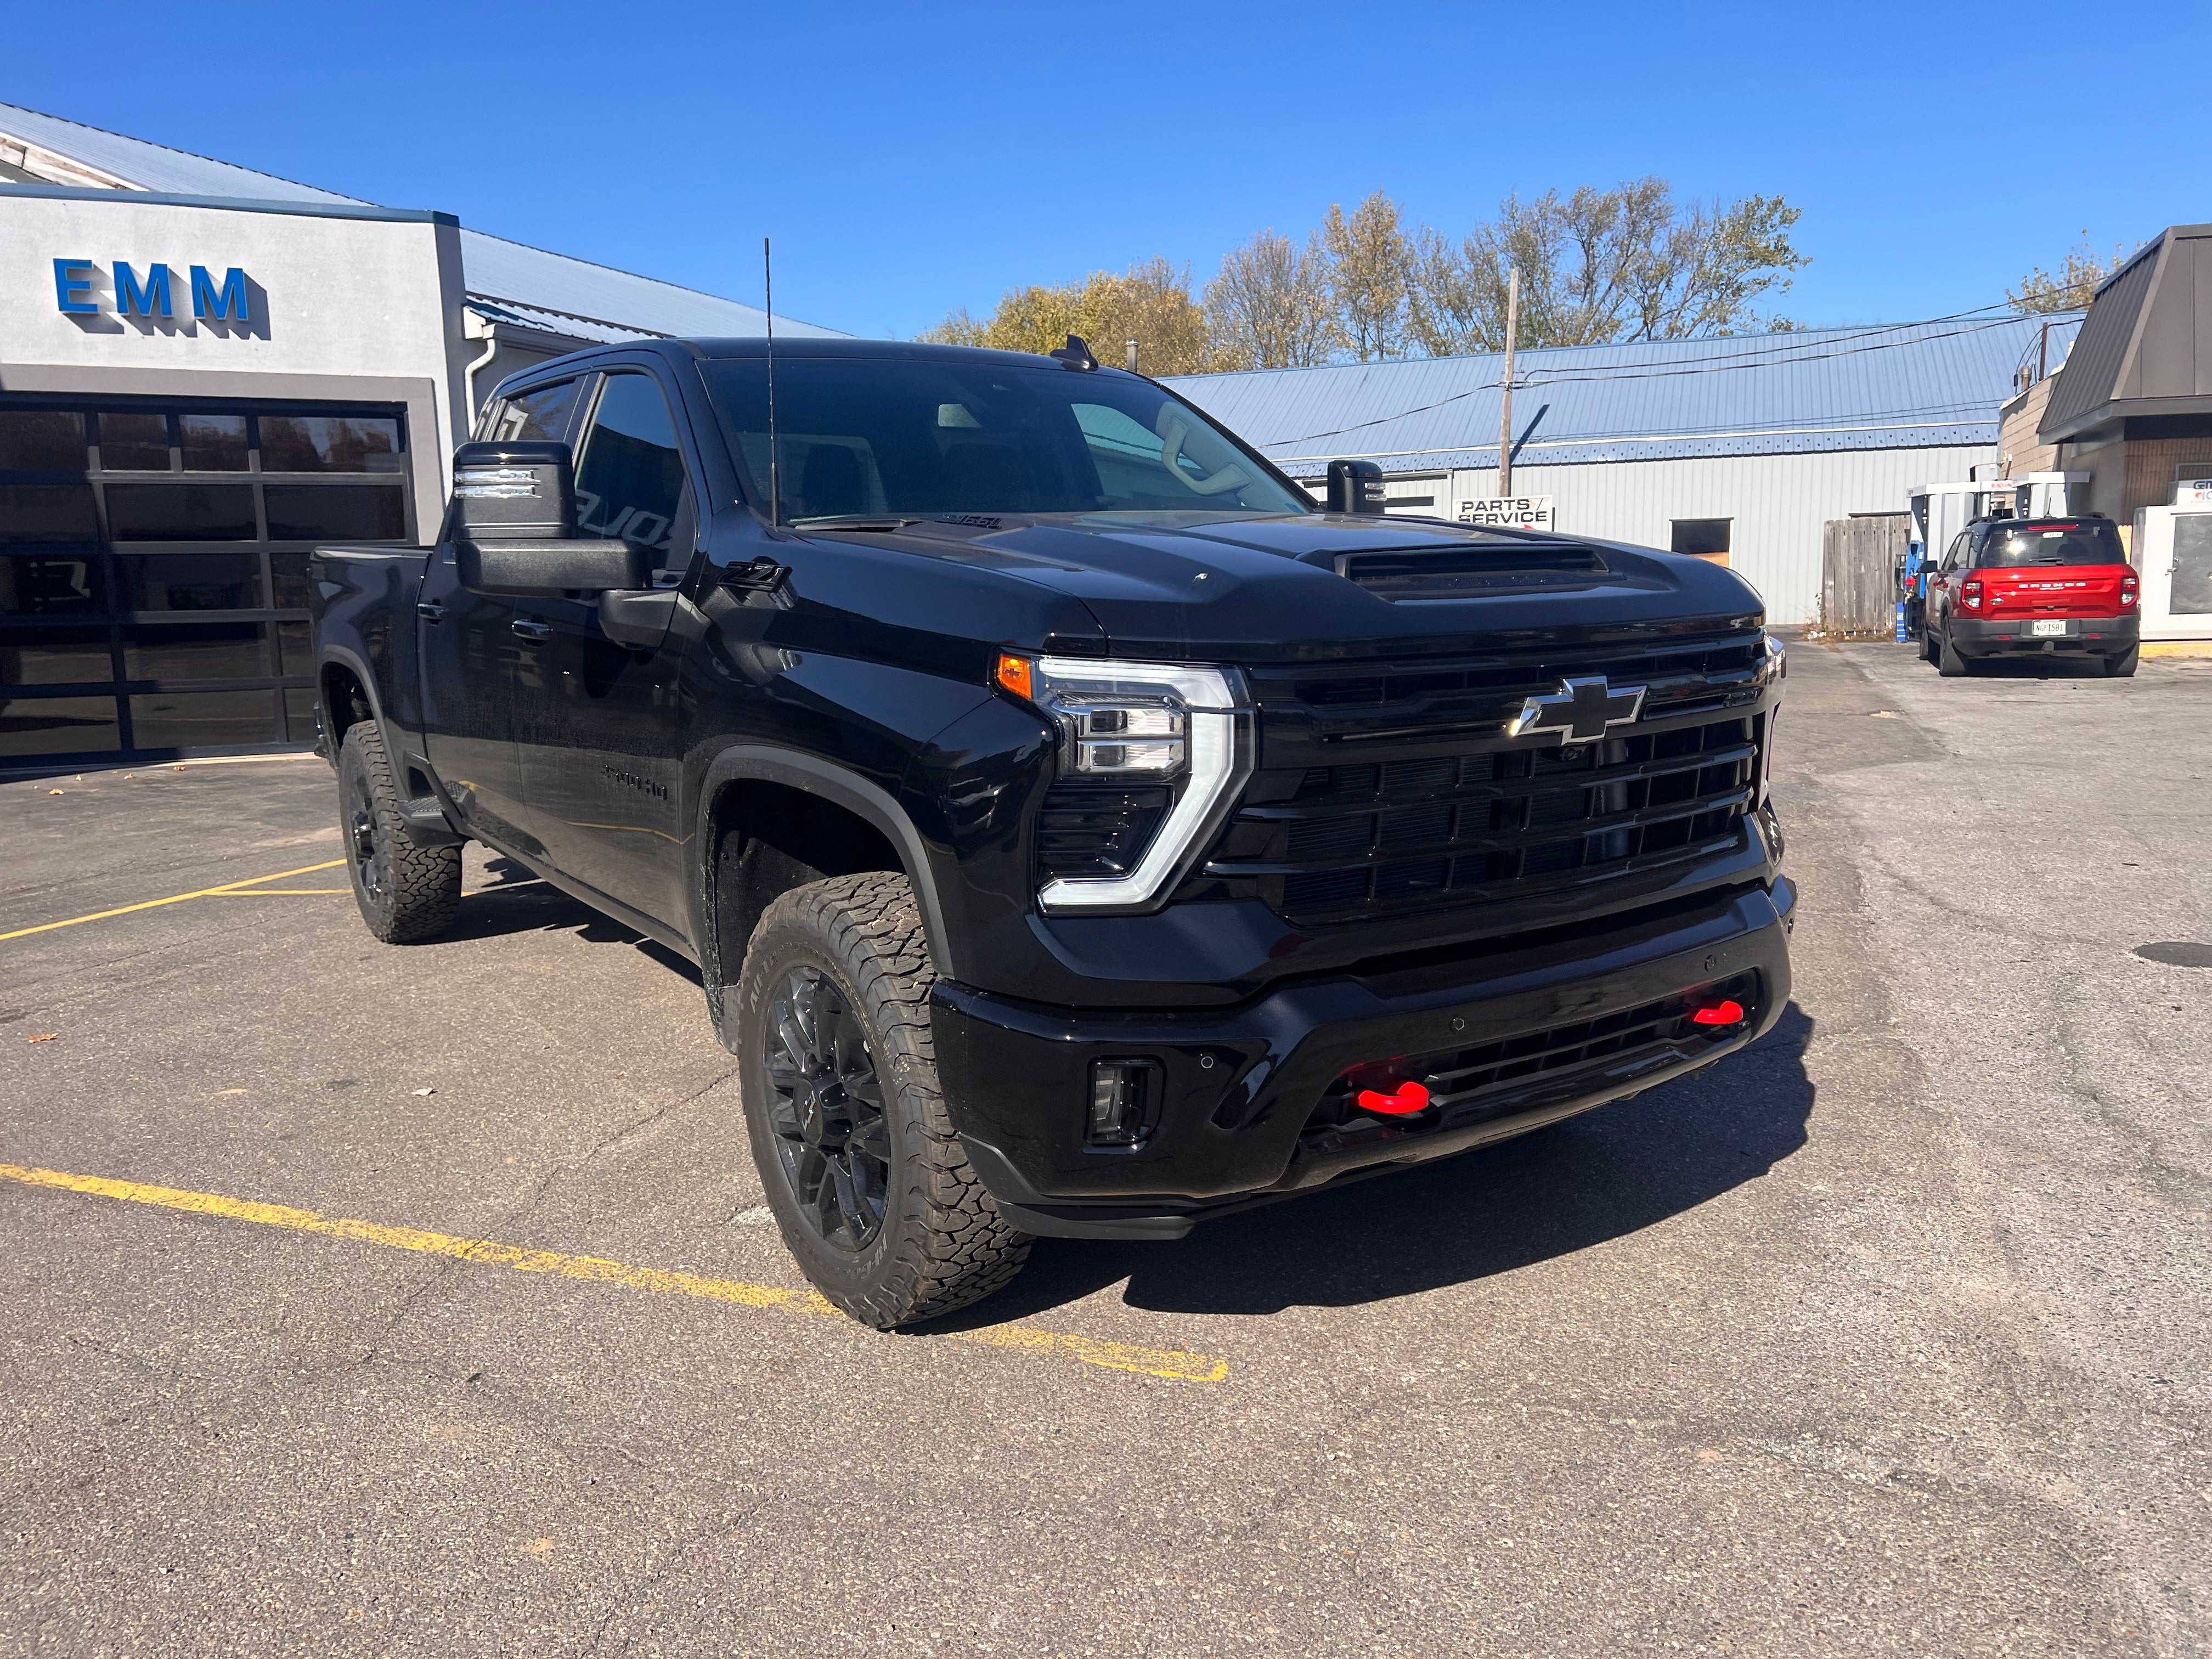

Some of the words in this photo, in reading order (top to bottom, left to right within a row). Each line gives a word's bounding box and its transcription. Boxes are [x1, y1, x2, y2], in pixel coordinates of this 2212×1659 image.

[53, 258, 249, 321] EMM
[1462, 499, 1530, 512] PARTS
[1458, 511, 1547, 524] SERVICE
[2018, 582, 2086, 590] BRONCO
